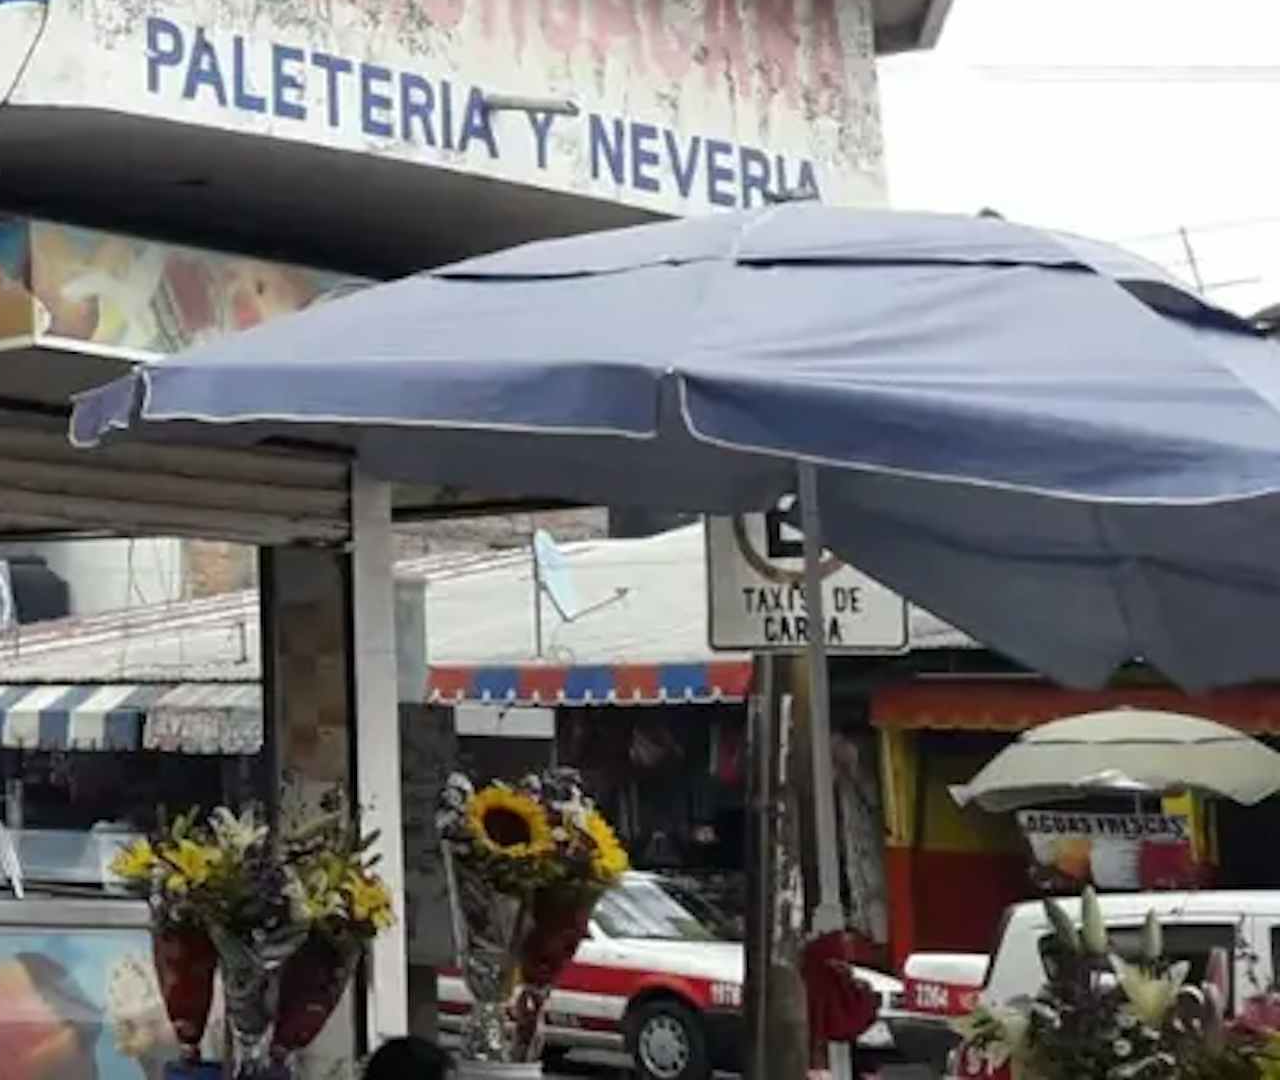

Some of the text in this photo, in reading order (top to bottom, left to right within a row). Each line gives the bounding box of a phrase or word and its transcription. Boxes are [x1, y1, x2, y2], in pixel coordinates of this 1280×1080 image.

[145, 16, 822, 210] PALETERIA Y NEVERIA
[833, 587, 863, 613] DE
[765, 617, 843, 643] CARA
